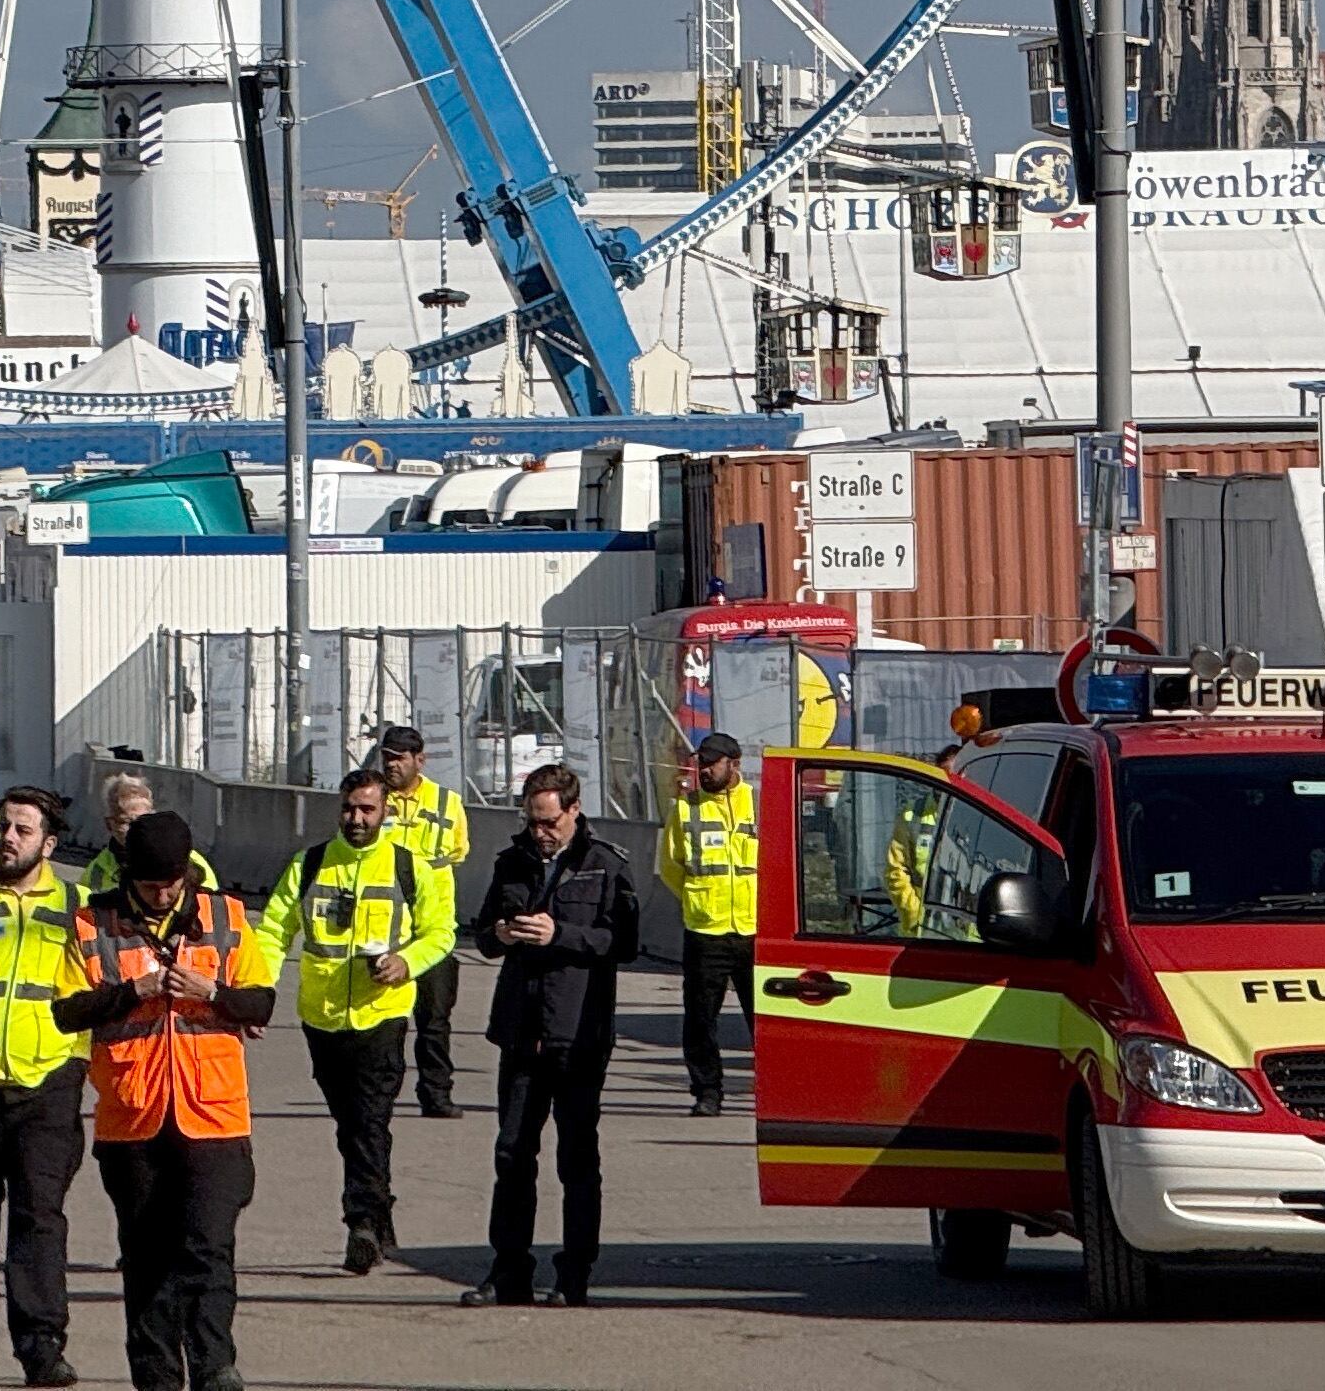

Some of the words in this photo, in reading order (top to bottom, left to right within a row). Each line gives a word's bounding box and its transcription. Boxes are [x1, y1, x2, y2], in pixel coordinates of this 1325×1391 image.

[818, 474, 883, 497] Straße
[892, 473, 903, 496] C
[32, 516, 71, 532] Straße
[76, 516, 83, 530] 8
[821, 545, 885, 568] Straße
[895, 544, 906, 567] 9
[743, 619, 765, 631] Die
